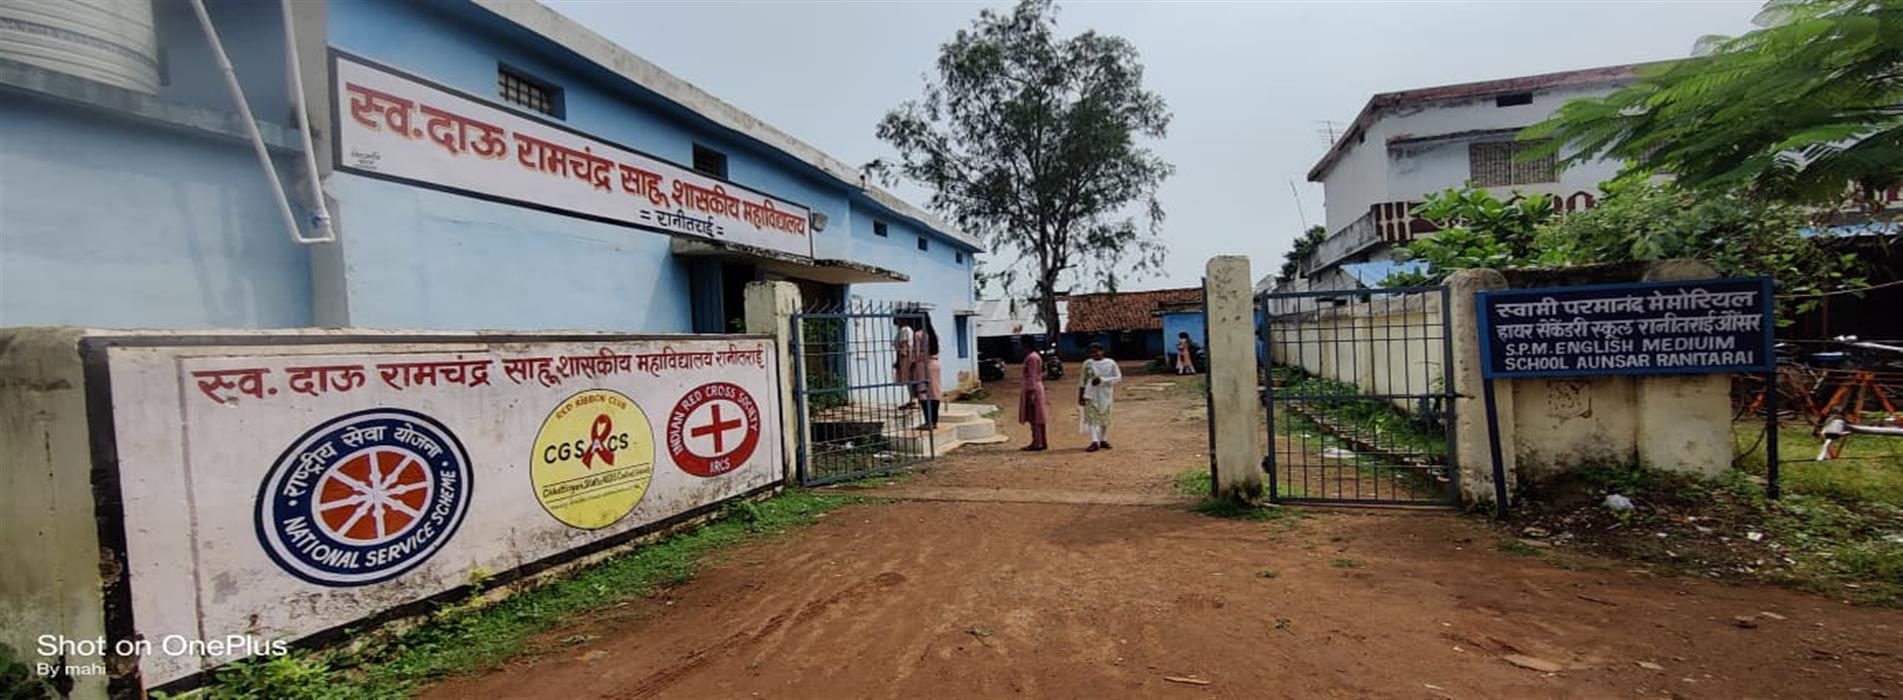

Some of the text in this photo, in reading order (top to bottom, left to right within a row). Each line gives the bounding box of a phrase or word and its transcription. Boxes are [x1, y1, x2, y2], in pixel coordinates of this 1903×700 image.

[513, 132, 615, 191] रामचंद्र
[619, 164, 670, 208] साहू
[672, 179, 739, 219] शासकीय
[742, 199, 806, 236] महाविद्यालय
[1495, 287, 1758, 318] स्वामी परमानंद मेमोरियल
[1496, 323, 1535, 343] हायर
[1590, 319, 1635, 340] स्कूल
[193, 343, 765, 404] स्व. दाऊ रामचंद्र साहू शासकीय महाविद्यालय रानीतराई
[1505, 351, 1754, 371] SCHOOL AUNSAR RANITARAI
[1642, 335, 1735, 352] MEDIUIM
[669, 411, 686, 456] INDIAN
[680, 390, 703, 412] RED
[705, 385, 736, 399] CROSS
[283, 422, 443, 497] राष्ट्रीय सेवा योजना
[283, 470, 457, 569] NATIONAL SERVICE SCHEME
